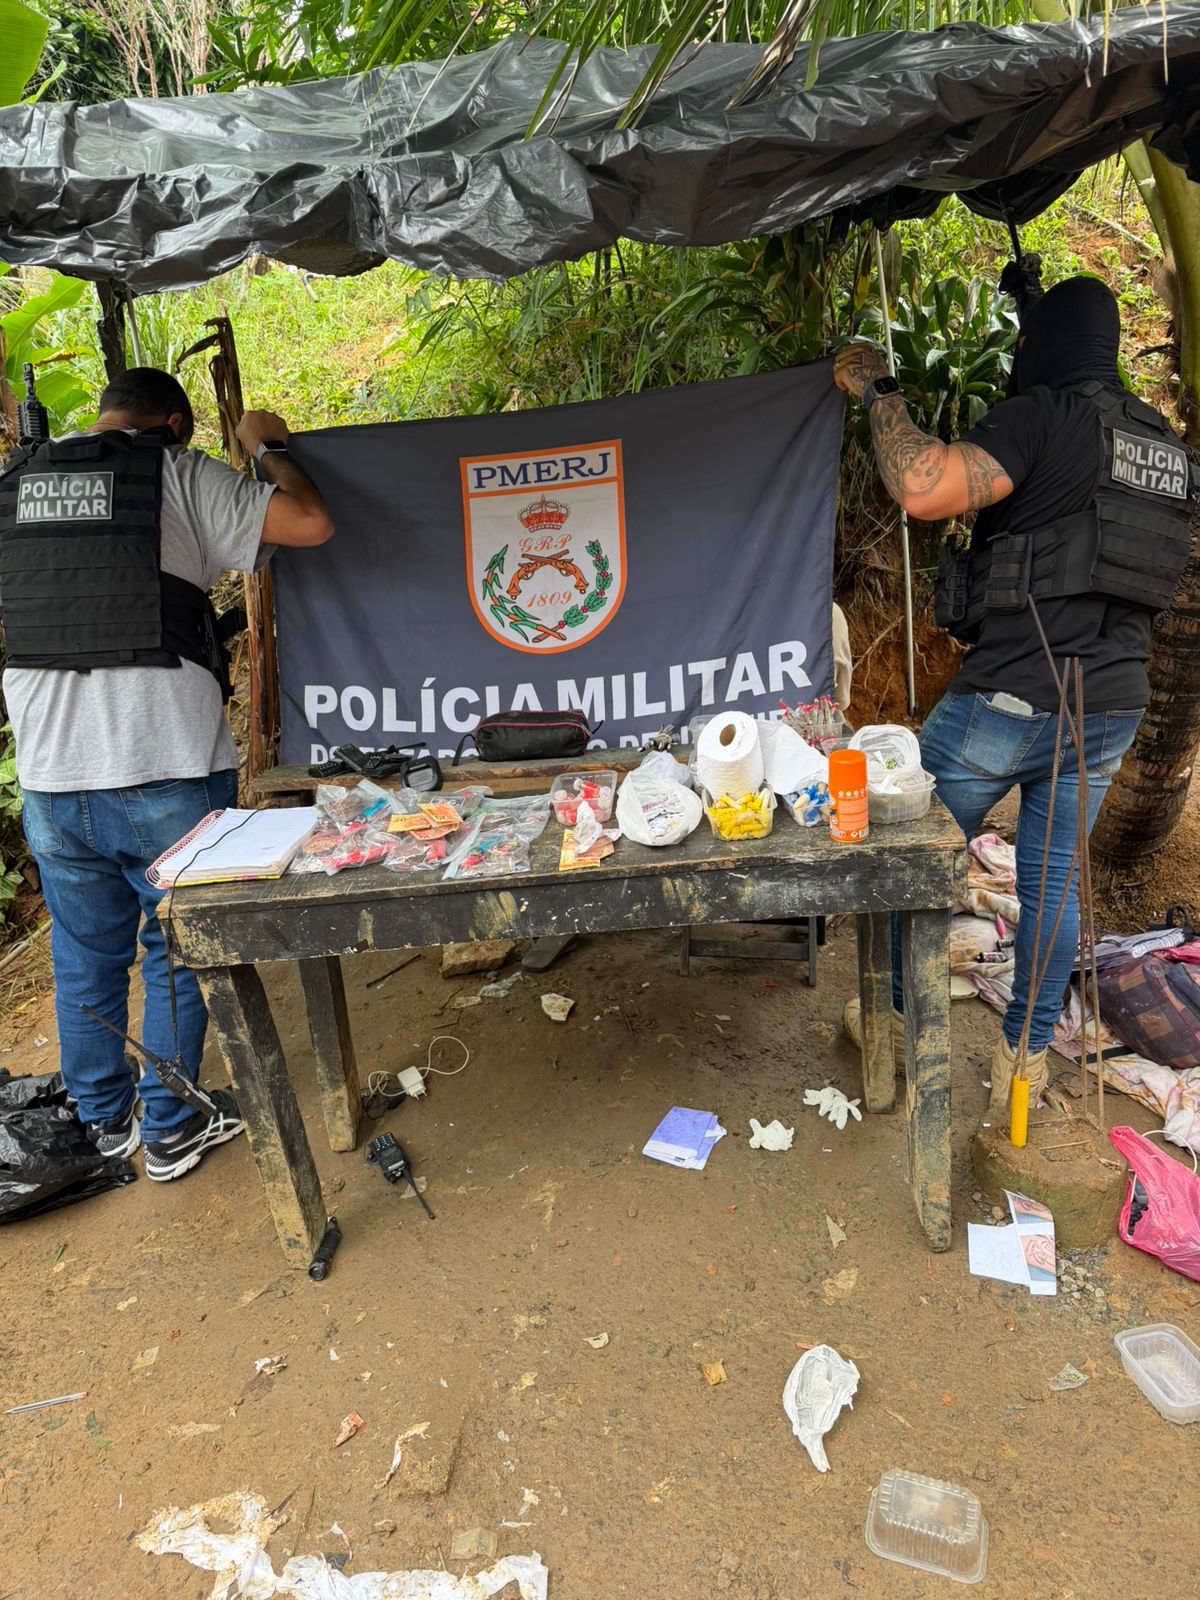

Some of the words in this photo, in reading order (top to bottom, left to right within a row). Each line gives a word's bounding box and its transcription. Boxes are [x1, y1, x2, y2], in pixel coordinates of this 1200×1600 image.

[473, 452, 611, 489] PMERJ
[1116, 438, 1185, 475] POLÍCIA
[20, 476, 107, 500] POLÍCIA
[1114, 458, 1184, 495] MILITAR
[19, 498, 108, 520] MILITAR
[527, 591, 572, 609] 1809
[304, 677, 545, 733] POLÍCIA
[556, 640, 812, 723] MILITAR
